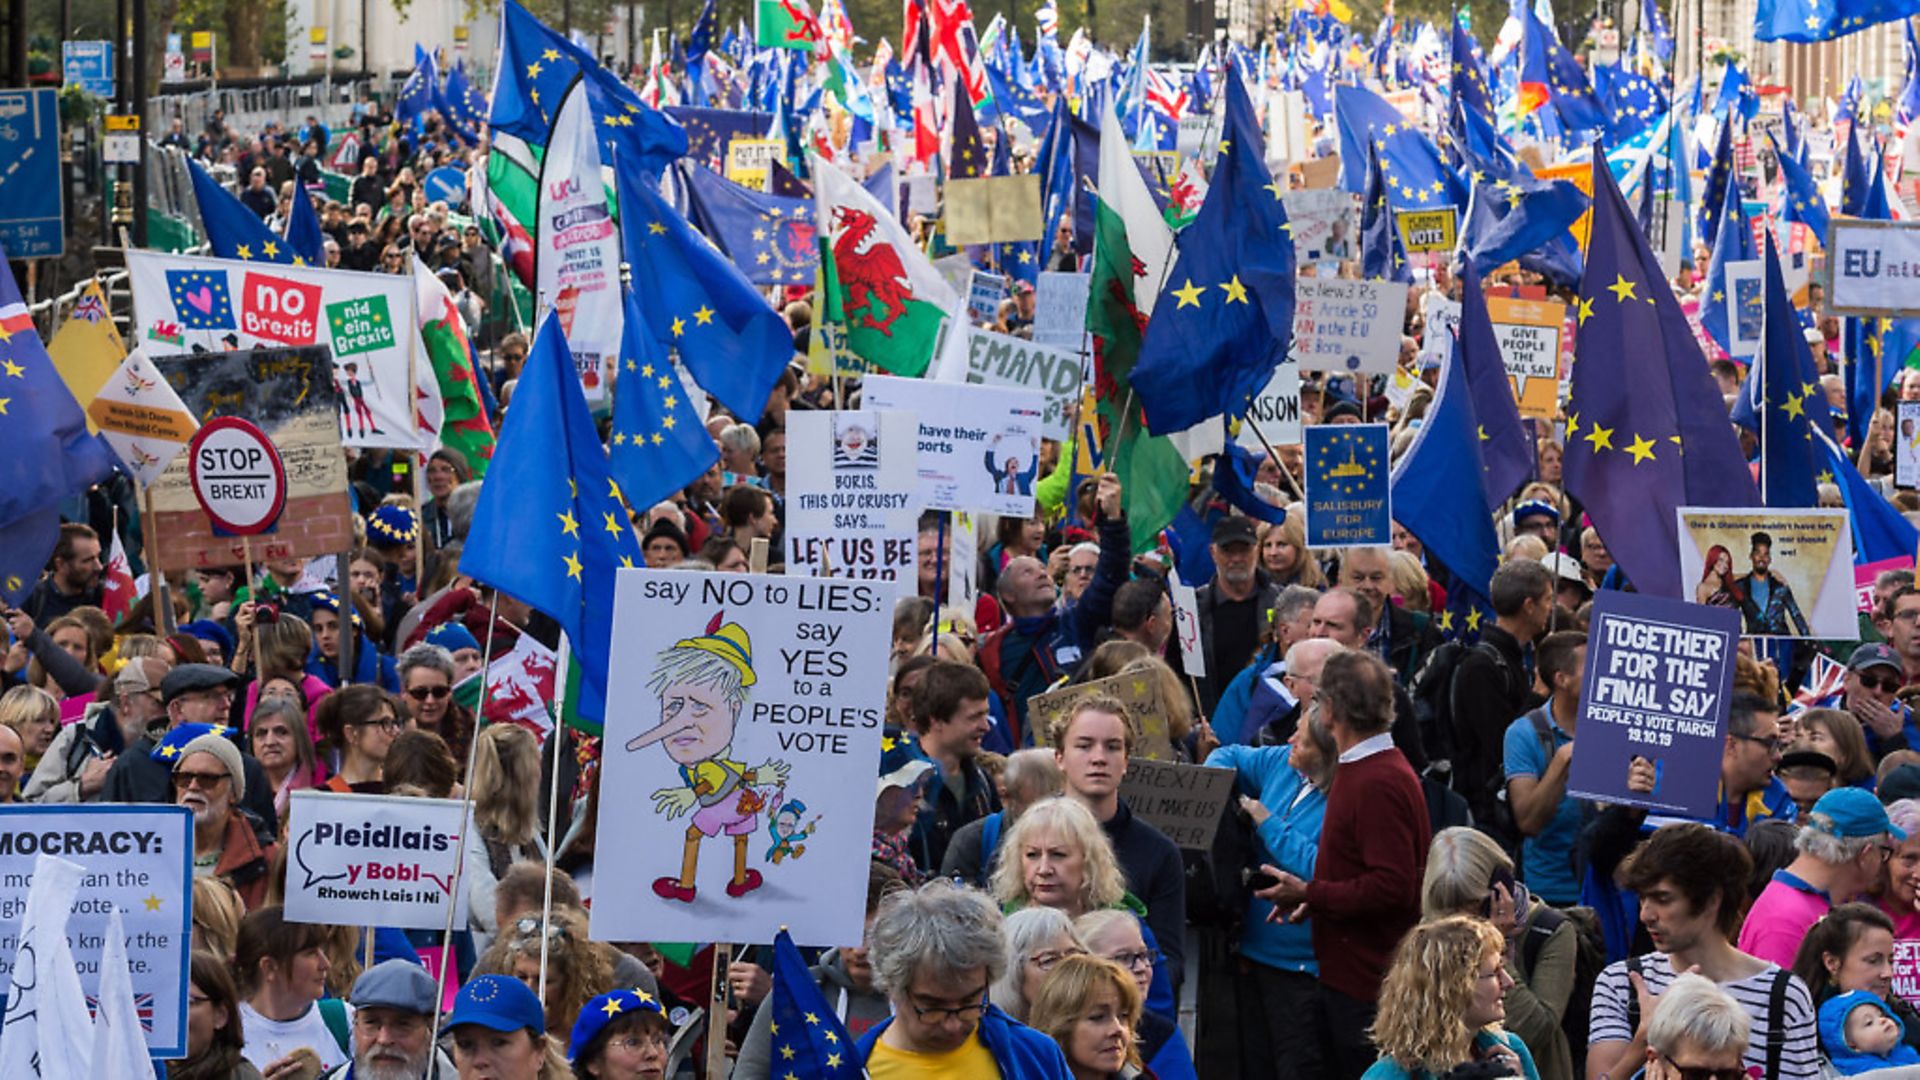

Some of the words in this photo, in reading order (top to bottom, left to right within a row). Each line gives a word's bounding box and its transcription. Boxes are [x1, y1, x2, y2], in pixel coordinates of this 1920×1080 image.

[1409, 229, 1443, 245] VOTE
[1844, 249, 1881, 278] EU
[256, 283, 305, 316] no
[1317, 283, 1345, 298] New
[344, 302, 371, 318] nid
[245, 311, 313, 339] Brexit
[344, 319, 371, 335] ein
[1512, 327, 1538, 339] GIVE
[336, 329, 391, 354] Brexit
[1503, 338, 1545, 351] PEOPLE
[969, 334, 1082, 395] EMAND
[1513, 352, 1534, 362] THE
[1531, 361, 1552, 374] SAY
[919, 423, 951, 438] have
[954, 427, 988, 441] their
[201, 449, 262, 471] STOP
[211, 484, 267, 499] BREXIT
[800, 495, 827, 509] THIS
[831, 494, 855, 509] OLD
[858, 494, 907, 509] CRUSTY
[1313, 500, 1383, 511] SALISBURY
[1335, 515, 1361, 524] FOR
[1751, 521, 1793, 530] shouldn't
[1794, 522, 1816, 530] have
[1322, 528, 1376, 539] EUROPE
[1797, 535, 1827, 543] should
[266, 545, 288, 558] EU
[792, 537, 834, 565] LET
[842, 537, 874, 566] US
[884, 539, 913, 566] BE
[644, 580, 690, 605] say
[702, 579, 753, 605] NO
[765, 584, 788, 604] to
[798, 584, 881, 612] LIES:
[796, 622, 842, 647] say
[1606, 619, 1722, 661] TOGETHER
[780, 649, 848, 677] YES
[1610, 650, 1659, 680] FOR
[1665, 657, 1710, 688] THE
[793, 680, 812, 696] to
[818, 684, 832, 696] a
[1103, 679, 1120, 695] in
[1596, 676, 1662, 712] FINAL
[1669, 689, 1716, 717] SAY
[752, 702, 879, 729] PEOPLE'S
[1587, 705, 1643, 727] PEOPLE'S
[1645, 717, 1674, 732] VOTE
[1677, 720, 1716, 737] MARCH
[778, 731, 848, 754] VOTE
[1627, 727, 1672, 747] 19.10.19
[314, 822, 448, 851] Pleidlais
[116, 869, 149, 887] the
[347, 865, 362, 885] y
[366, 862, 420, 881] Bobl
[317, 887, 379, 901] Rhowch
[383, 889, 413, 903] Lais
[423, 891, 440, 905] Ni
[136, 931, 168, 949] the
[75, 960, 98, 974] ou
